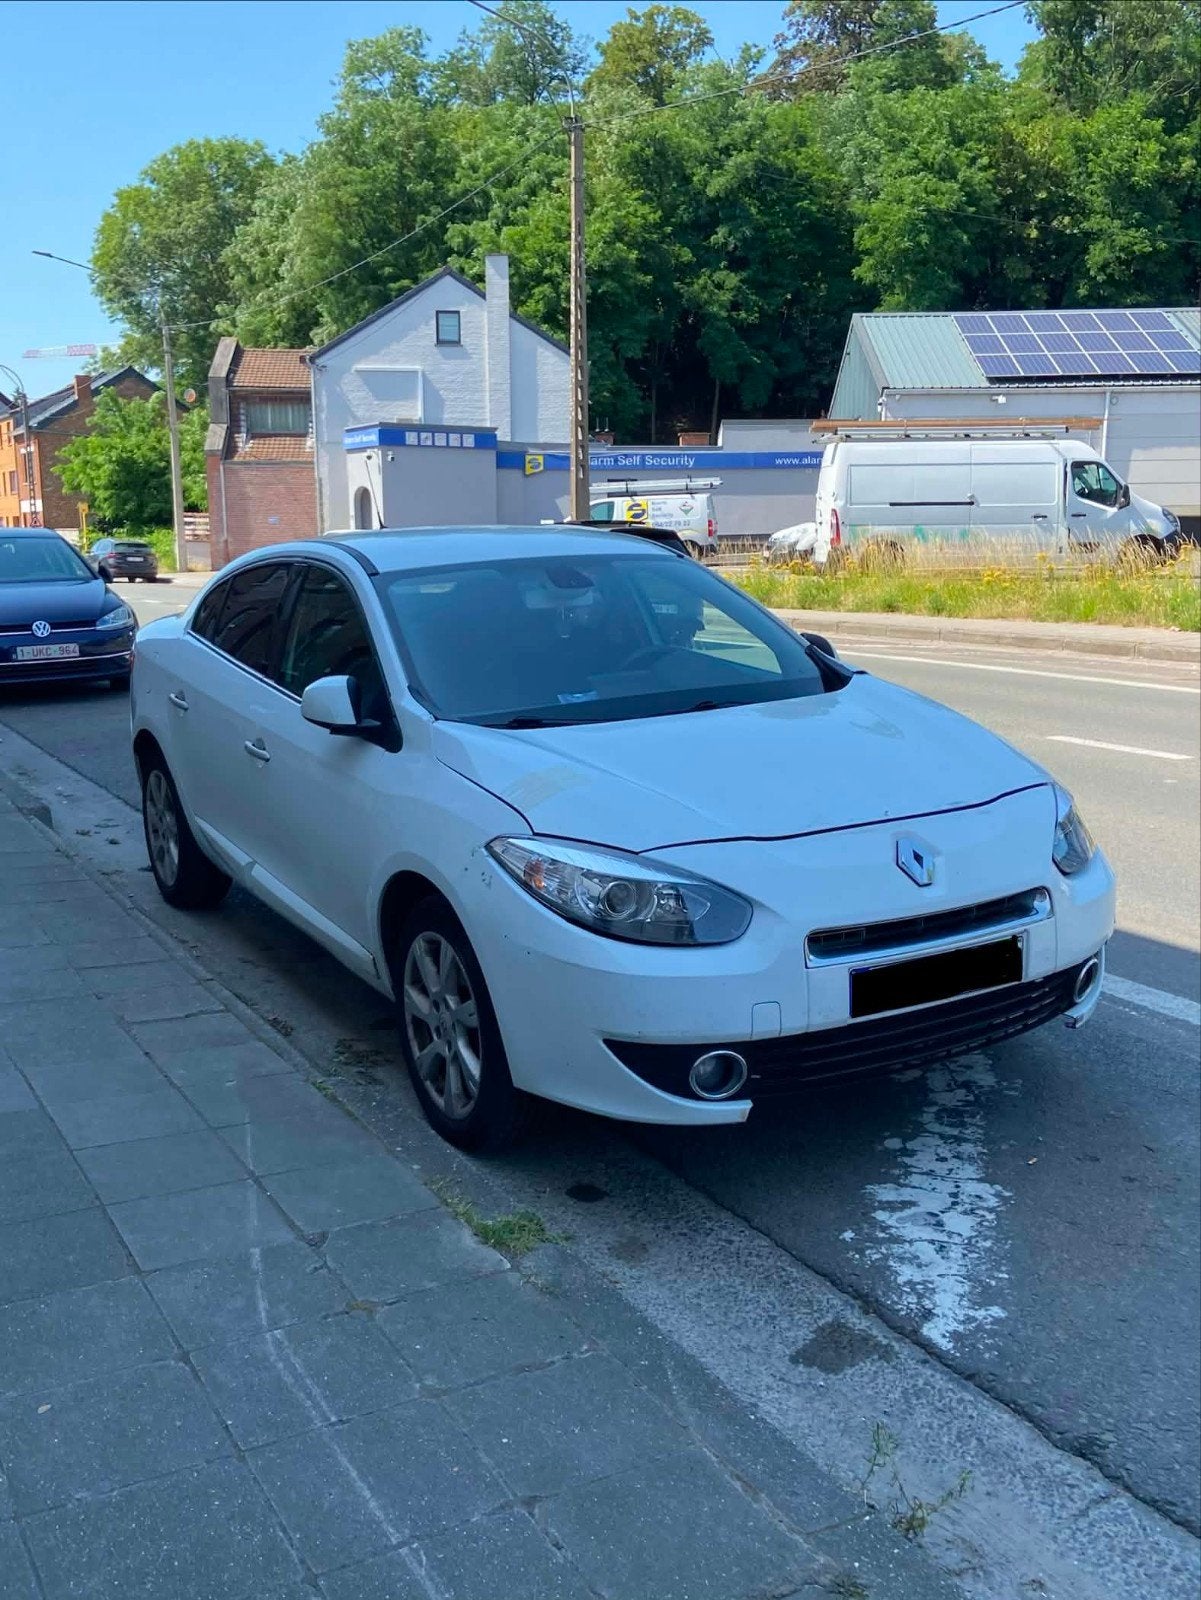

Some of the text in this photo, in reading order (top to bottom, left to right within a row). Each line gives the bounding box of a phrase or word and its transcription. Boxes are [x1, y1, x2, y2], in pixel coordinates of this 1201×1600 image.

[618, 455, 640, 466] Self
[645, 455, 695, 468] Security
[774, 455, 821, 465] www.alar
